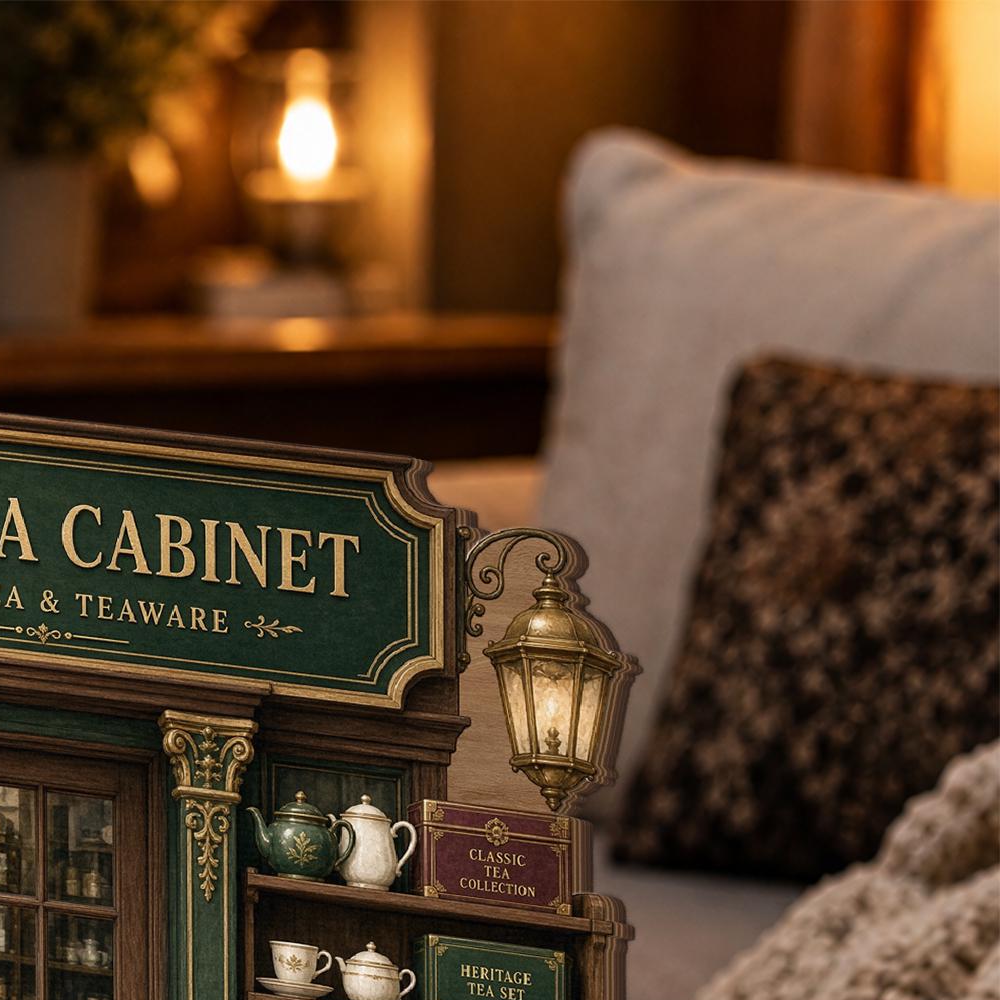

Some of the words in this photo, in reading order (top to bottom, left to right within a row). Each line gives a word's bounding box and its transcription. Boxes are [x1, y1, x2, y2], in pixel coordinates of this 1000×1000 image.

[61, 504, 360, 598] CABINET
[40, 589, 60, 614] &
[75, 594, 228, 633] TEAWARE
[469, 849, 526, 867] CLASSIC
[483, 866, 510, 880] TEA
[460, 877, 536, 898] COLLECTION
[460, 964, 532, 986] HERITAGE
[467, 982, 495, 999] TEA
